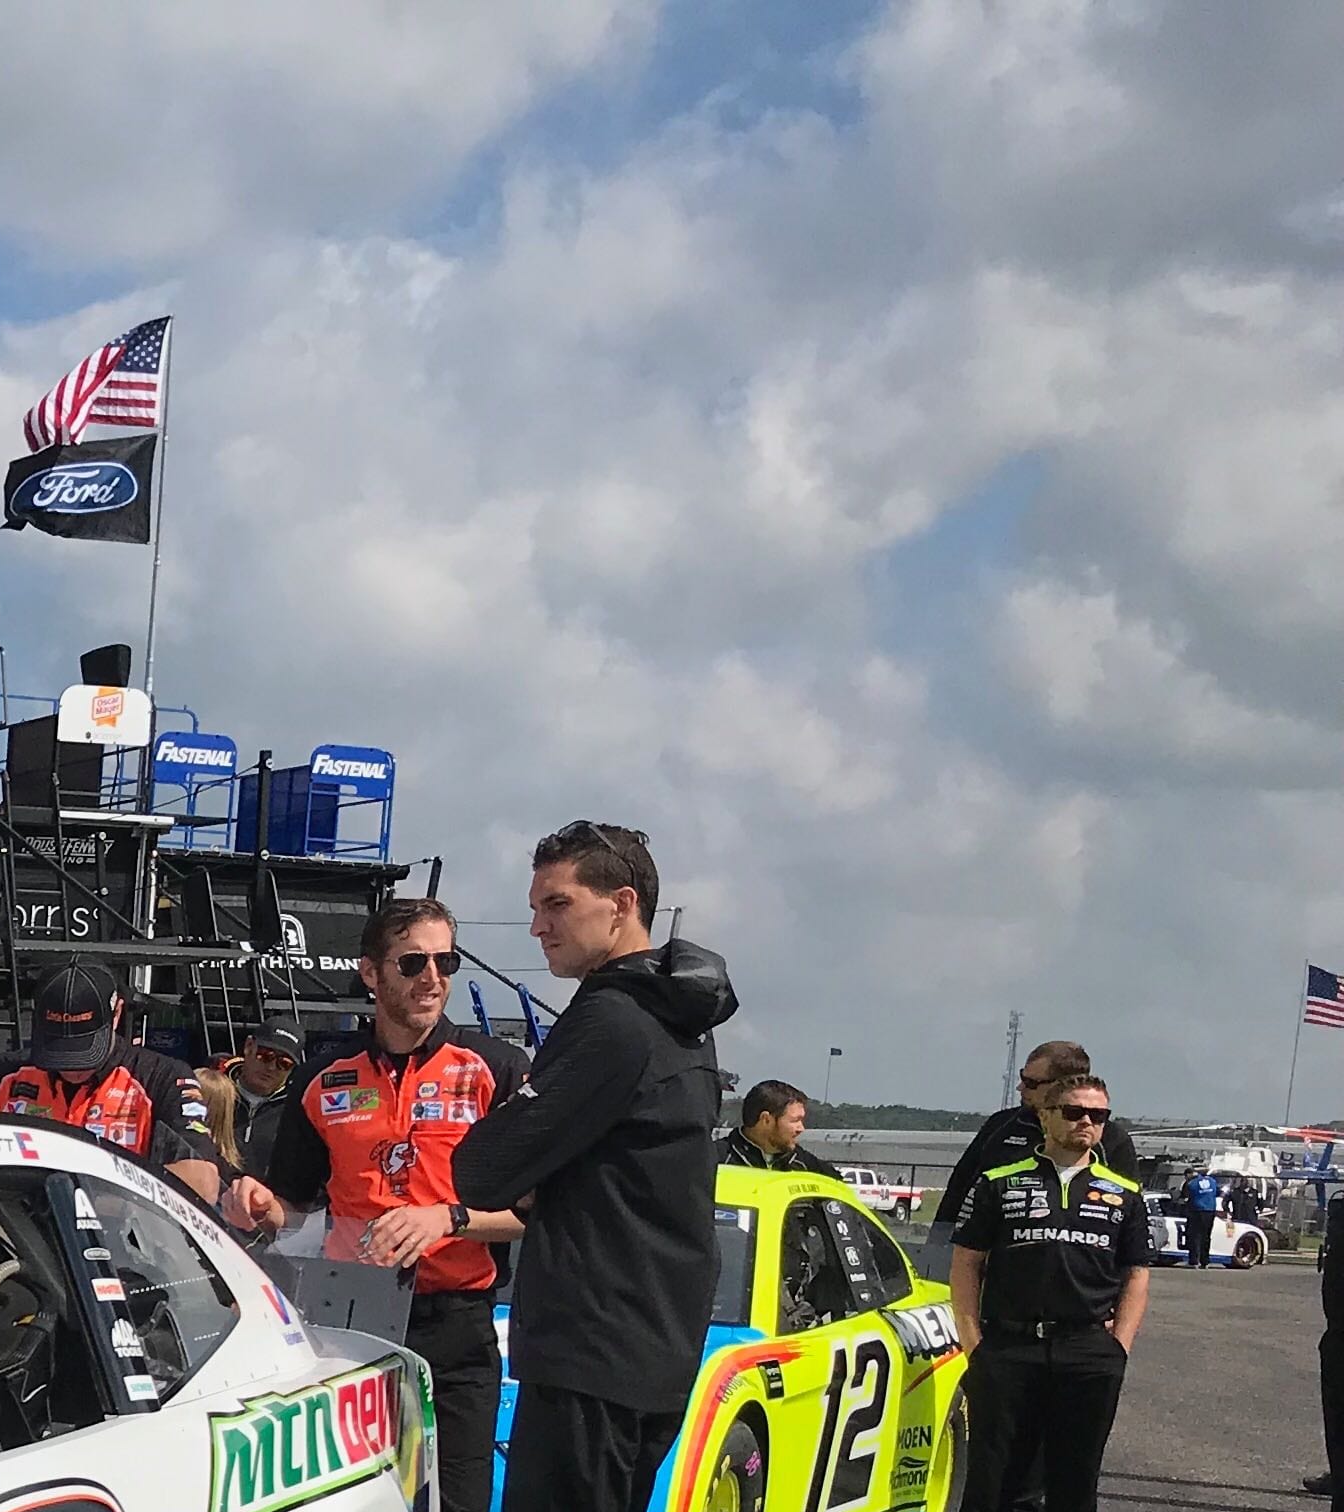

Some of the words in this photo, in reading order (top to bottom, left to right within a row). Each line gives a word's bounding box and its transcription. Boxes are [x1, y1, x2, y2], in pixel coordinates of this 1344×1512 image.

[32, 467, 120, 506] Ford
[156, 740, 234, 767] FASTENAL
[311, 753, 388, 779] FASTENAL
[112, 1154, 156, 1203] Kelley
[157, 1183, 189, 1219] Blue
[186, 1207, 225, 1248] Book
[1013, 1228, 1111, 1248] MENARDS
